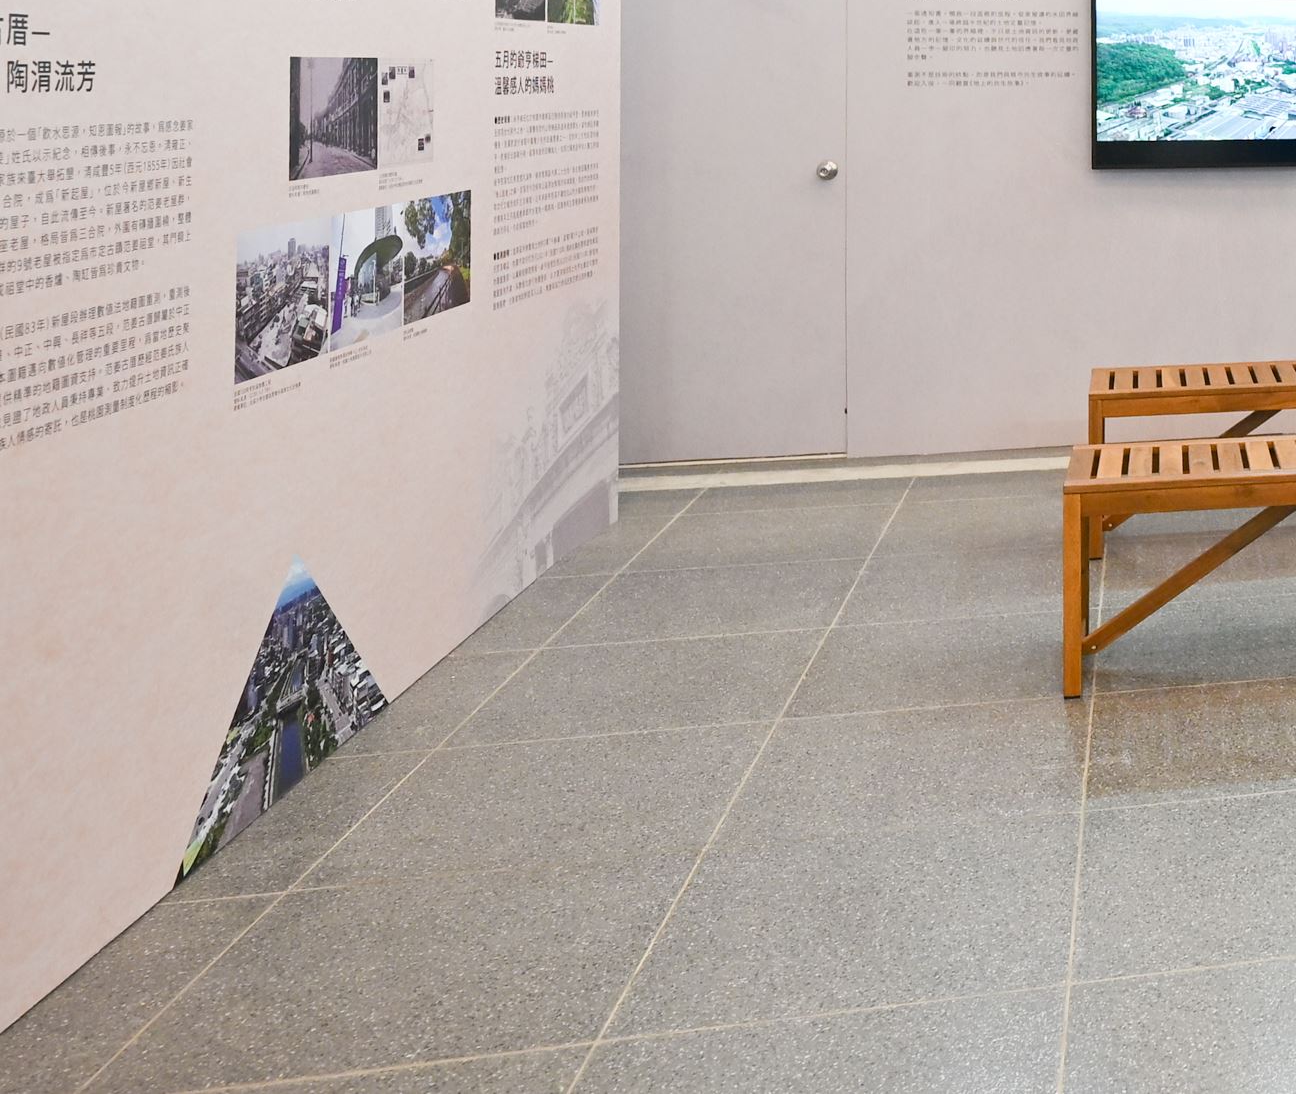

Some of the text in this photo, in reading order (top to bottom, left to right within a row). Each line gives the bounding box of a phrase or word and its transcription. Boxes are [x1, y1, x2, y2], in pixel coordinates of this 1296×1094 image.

[0, 13, 50, 46] 厝—
[6, 60, 96, 94] 陶渭流芳
[495, 76, 555, 95] 溫馨感人的媽媽桃
